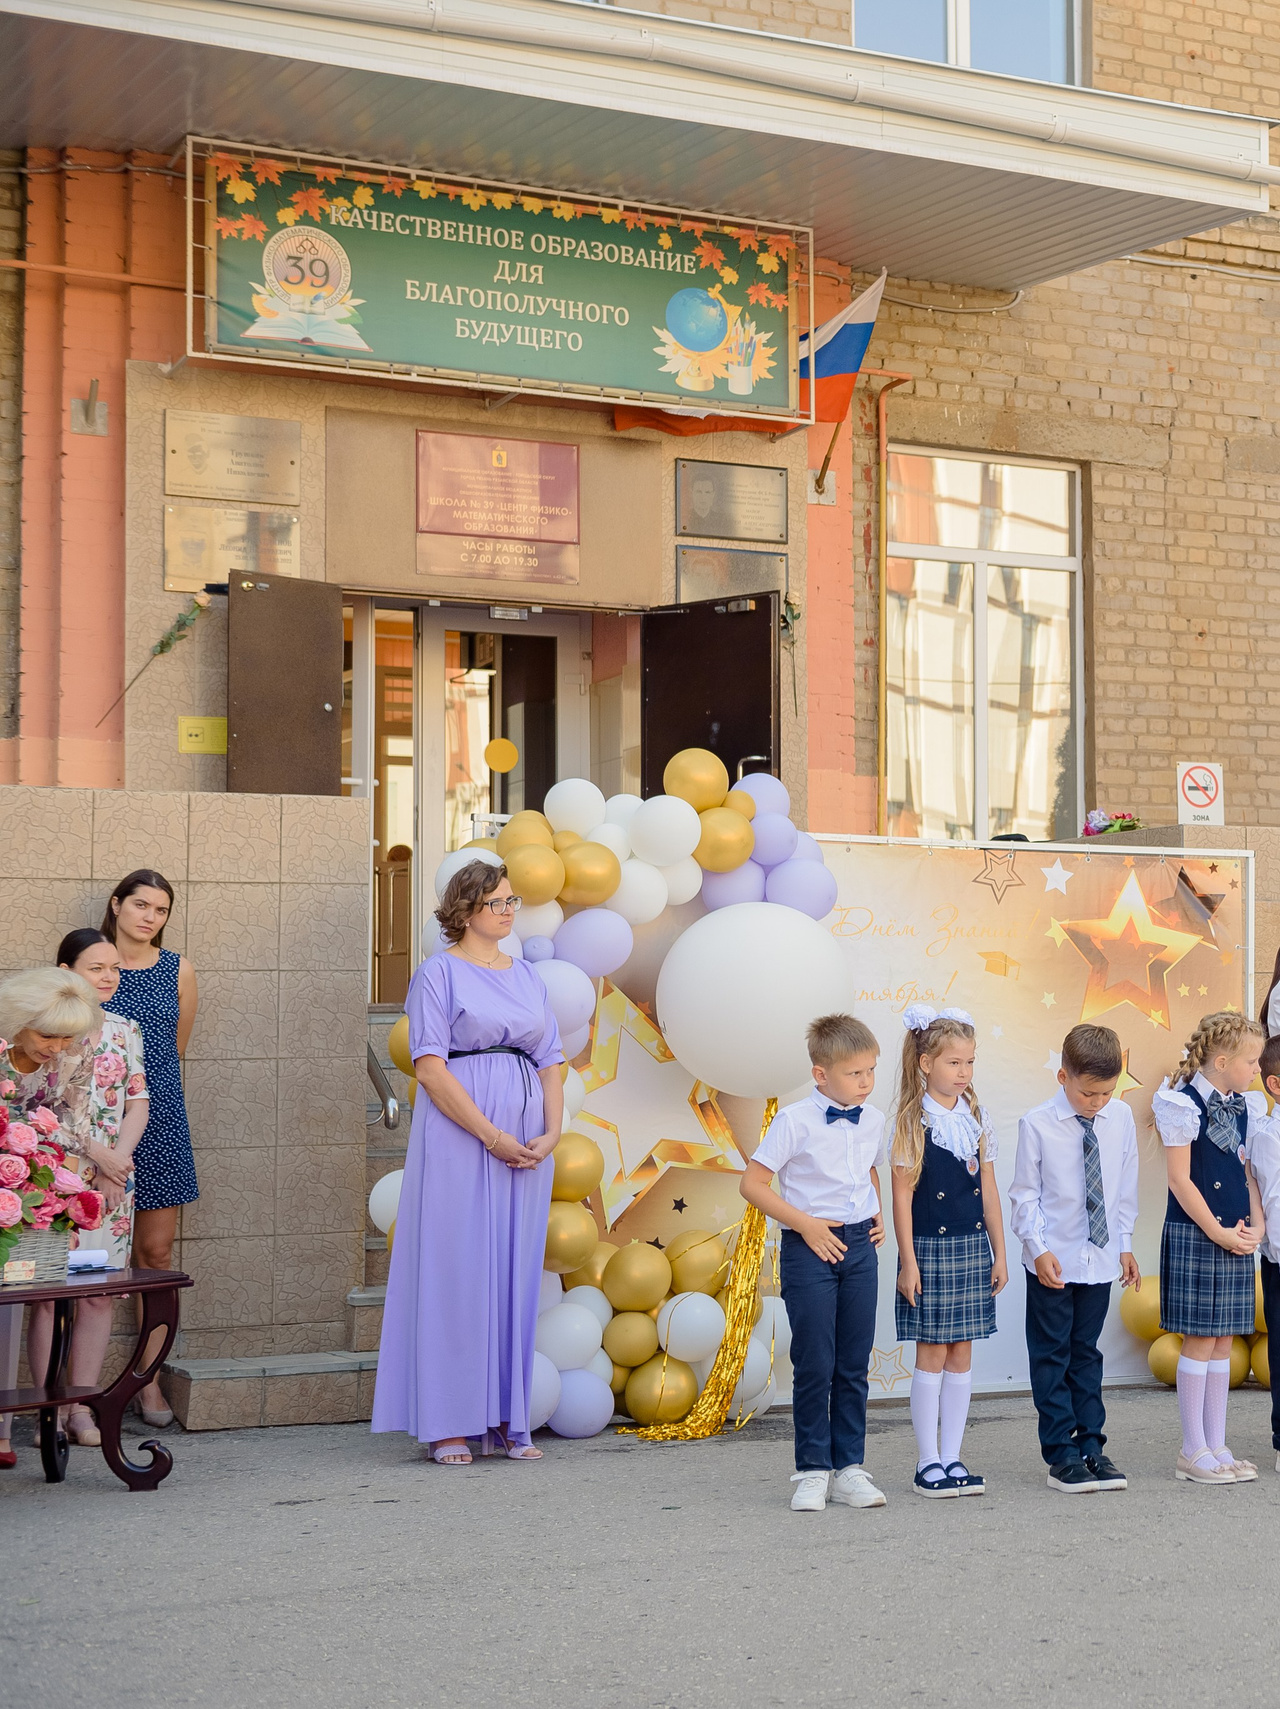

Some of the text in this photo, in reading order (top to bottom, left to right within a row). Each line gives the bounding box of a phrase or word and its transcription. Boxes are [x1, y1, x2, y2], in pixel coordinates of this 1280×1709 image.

[329, 204, 699, 275] КАЧЕСТВЕННОЕ ОБРАЗОВАНИЕ
[283, 255, 330, 288] 39
[493, 260, 545, 286] ДЛЯ
[405, 279, 631, 328] БЛАГОПОЛУЧНОГО
[454, 317, 584, 353] БУДУЩЕГО
[453, 510, 548, 525] МАТЕМАТИЧЕСКОГО
[470, 500, 481, 509] №
[483, 500, 494, 509] 39
[460, 553, 539, 567] С 7.00 ДО 19.30
[462, 540, 536, 555] ЧАСЫ РАБОТЫ
[1192, 814, 1210, 822] ЗОНА
[830, 902, 1041, 958] Днём Знаний!
